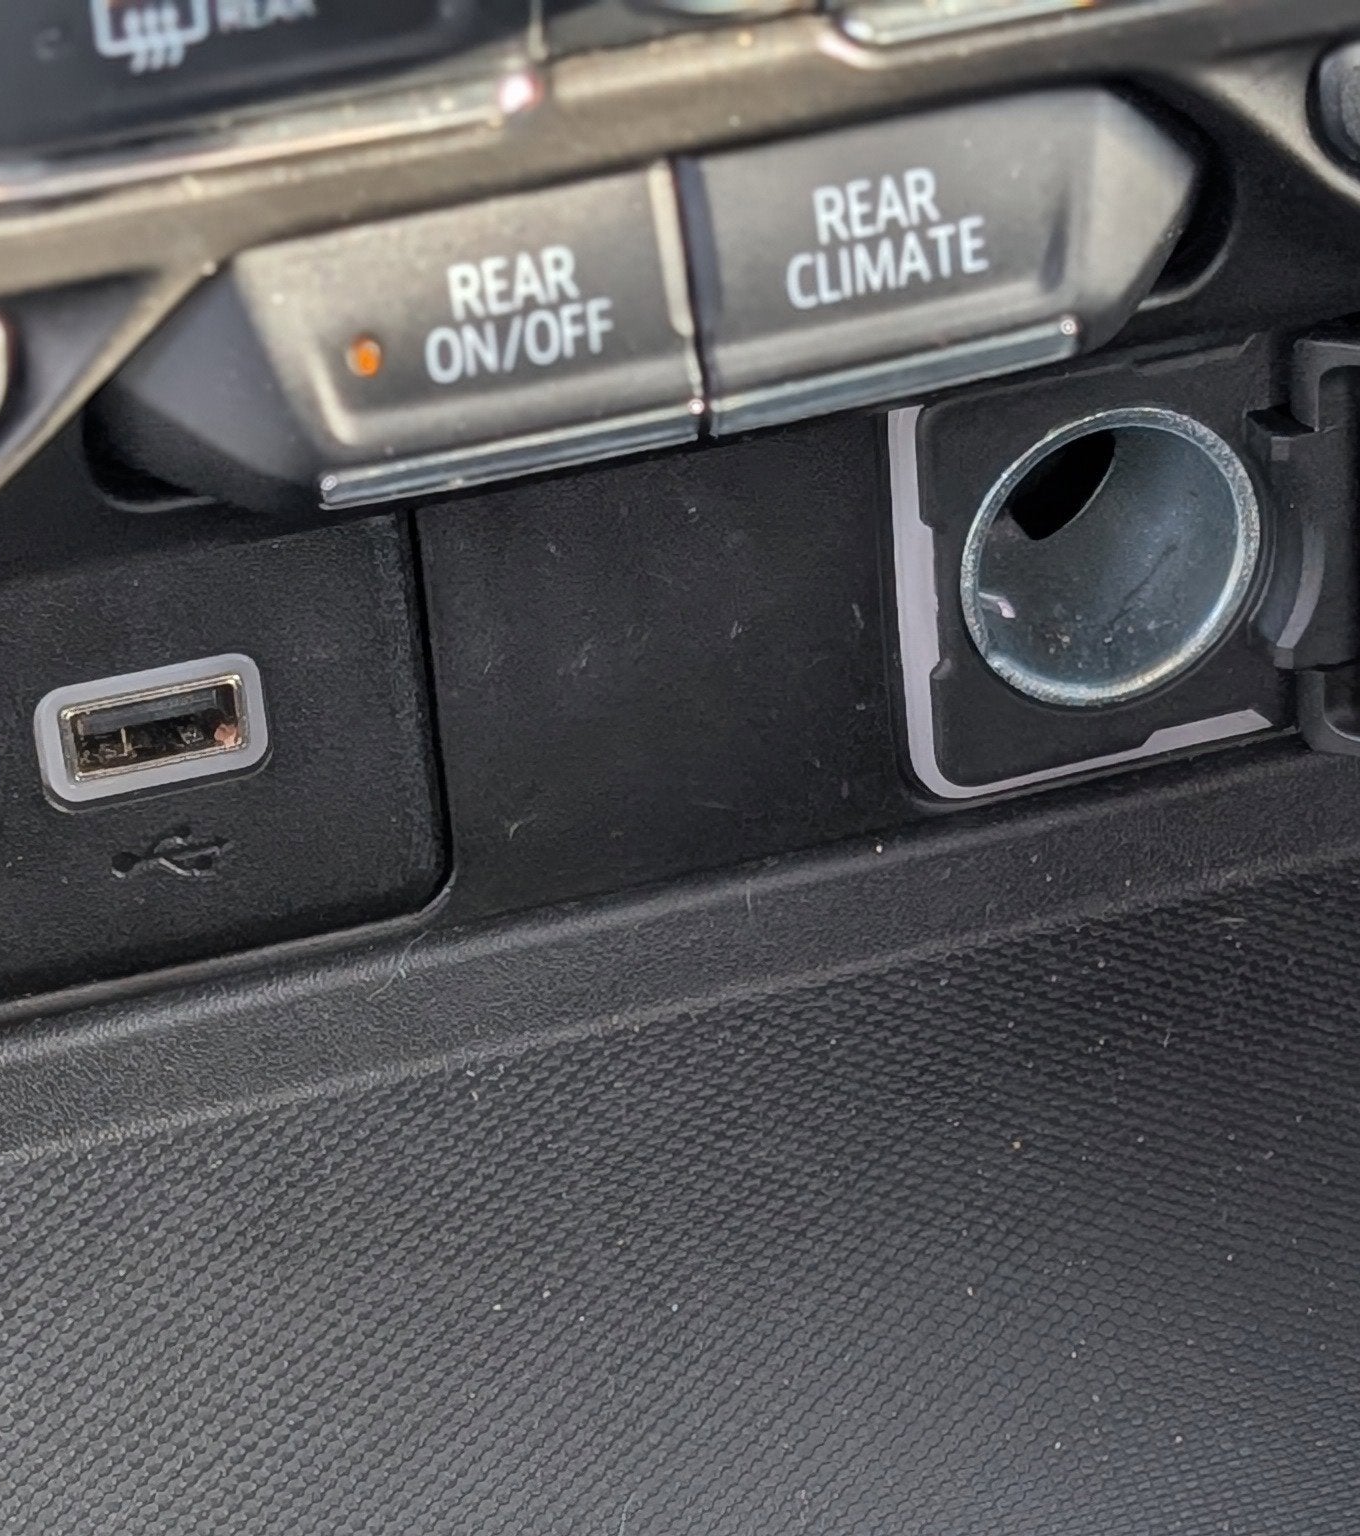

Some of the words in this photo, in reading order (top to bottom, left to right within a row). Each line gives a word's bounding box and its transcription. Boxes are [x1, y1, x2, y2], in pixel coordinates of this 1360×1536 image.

[812, 167, 940, 244] REAR
[447, 245, 580, 321] REAR
[785, 215, 990, 309] CLIMATE
[424, 297, 614, 384] ON/OFF
